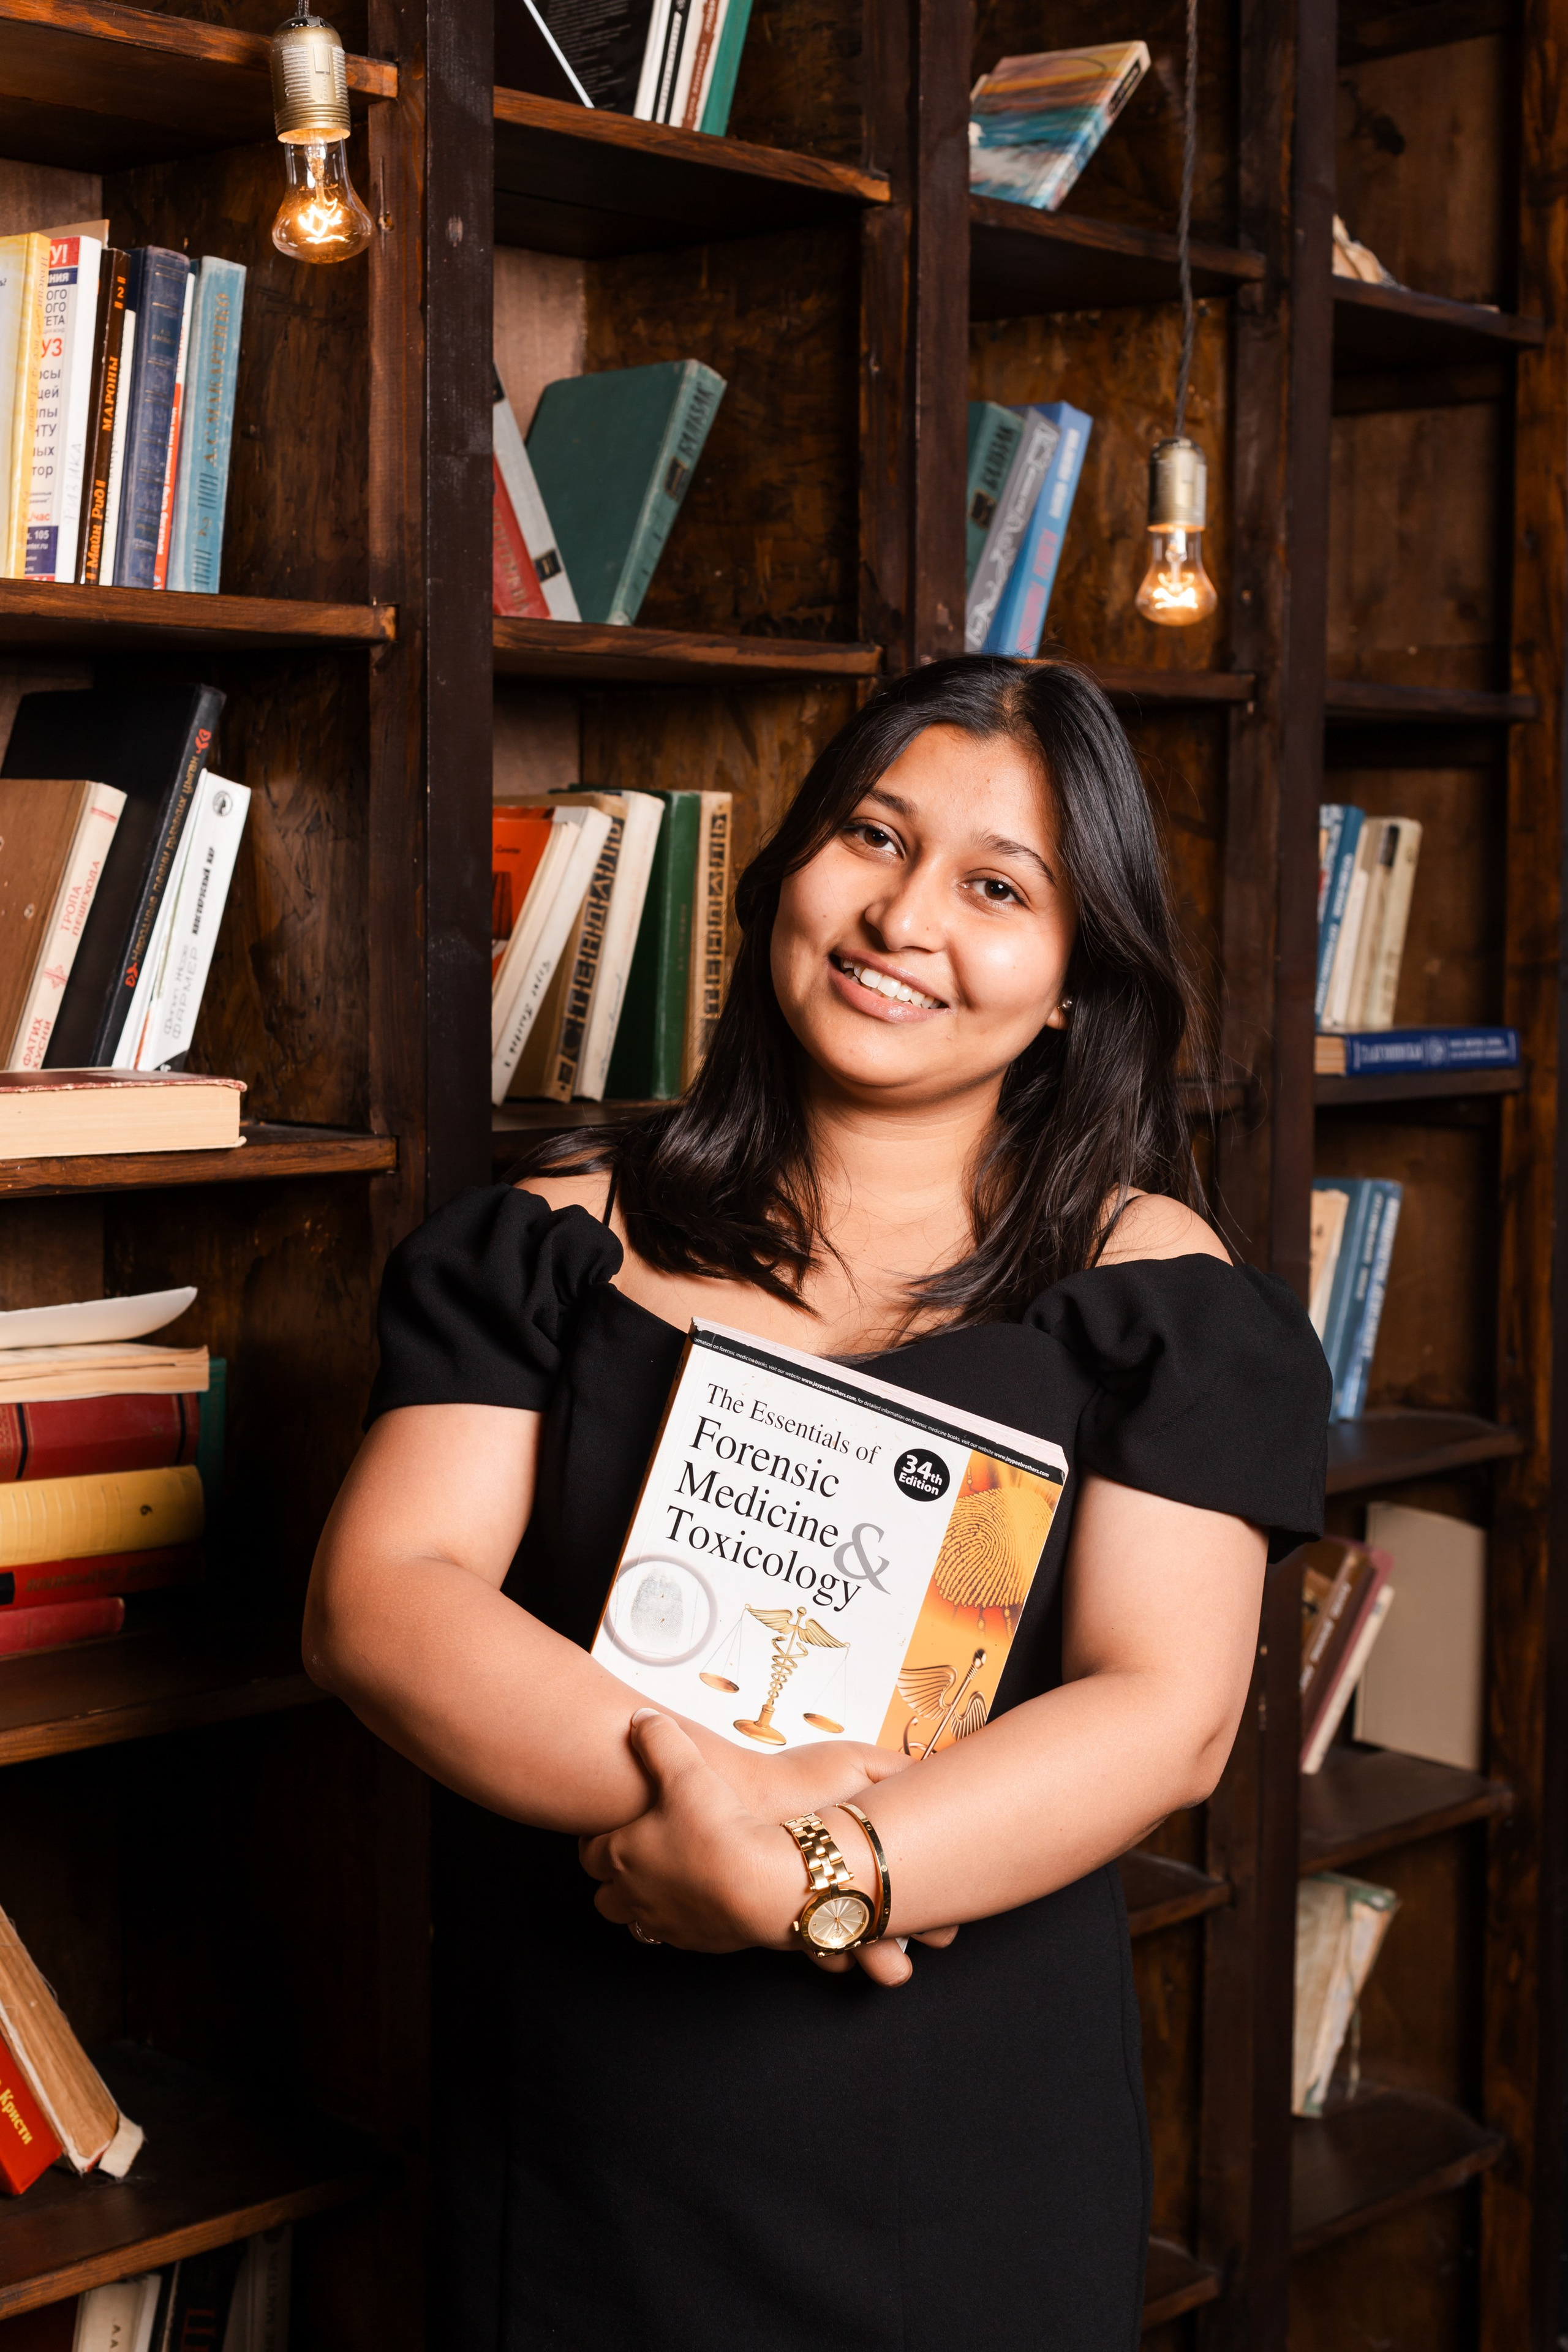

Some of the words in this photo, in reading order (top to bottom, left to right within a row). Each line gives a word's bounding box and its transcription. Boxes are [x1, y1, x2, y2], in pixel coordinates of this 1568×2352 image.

[117, 287, 124, 298] 2
[102, 355, 118, 432] МАРОНЫ
[678, 381, 715, 459] БАЛЬЗАК
[91, 488, 105, 520] Рид
[86, 524, 102, 569] Майн
[132, 895, 158, 962] Народные
[153, 851, 169, 892] песни
[165, 796, 187, 850] русских
[182, 755, 200, 796] цыган
[60, 885, 82, 932] ТРОПА
[71, 860, 100, 937] ПЕШЕХОДА
[702, 815, 727, 1035] ТЕНДАЛЬ
[562, 820, 624, 1058] СТЕНДАЛЬ
[172, 946, 198, 1039] ФАРМЕР
[23, 1017, 44, 1067] ФАТИХ
[32, 1020, 52, 1070] ХУСНИ
[707, 1383, 744, 1414] The
[748, 1399, 850, 1455] Essentials
[855, 1445, 882, 1464] of
[718, 1345, 736, 1357] forensic
[755, 1359, 768, 1369] books,
[785, 1370, 801, 1381] website
[801, 1377, 858, 1403] www.jaypeebrothers.com,
[864, 1399, 881, 1411] detailed
[881, 1406, 905, 1421] information
[911, 1417, 928, 1430] forensic
[927, 1424, 948, 1438] medicine
[947, 1432, 961, 1443] books,
[978, 1444, 995, 1455] website
[993, 1451, 1050, 1478] www.jaypeebrothers.com
[689, 1415, 840, 1498] Forensic
[899, 1471, 940, 1496] Edition
[902, 1454, 943, 1486] 34th
[665, 1505, 862, 1612] Toxicology
[674, 1460, 839, 1548] Medicine
[833, 1523, 891, 1595] &
[0, 2087, 33, 2145] Кристи
